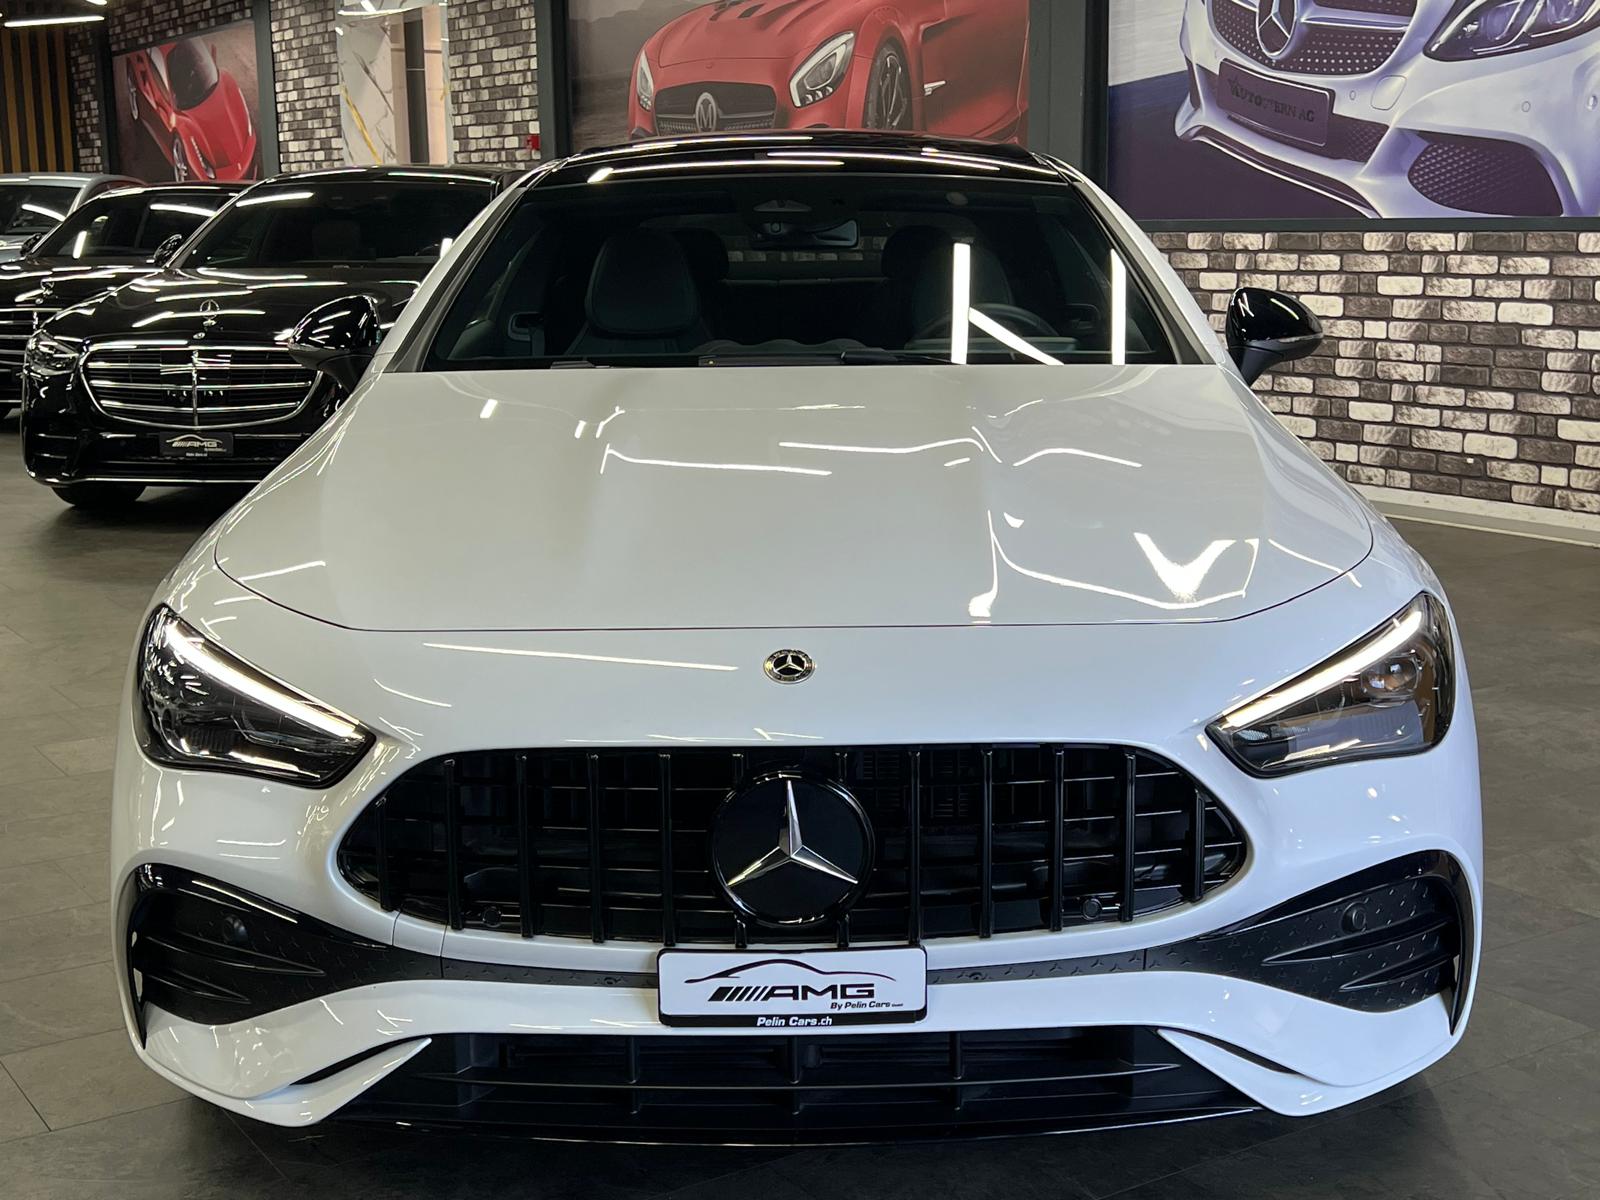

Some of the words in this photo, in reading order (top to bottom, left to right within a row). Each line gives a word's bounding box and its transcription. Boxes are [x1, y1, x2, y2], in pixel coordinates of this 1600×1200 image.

[760, 983, 875, 1002] AMG
[830, 1002, 843, 1011] By
[844, 1001, 867, 1009] Pelin
[868, 1000, 890, 1008] Cars
[756, 1016, 786, 1027] Pelin
[788, 1015, 833, 1026] Cars.ch
